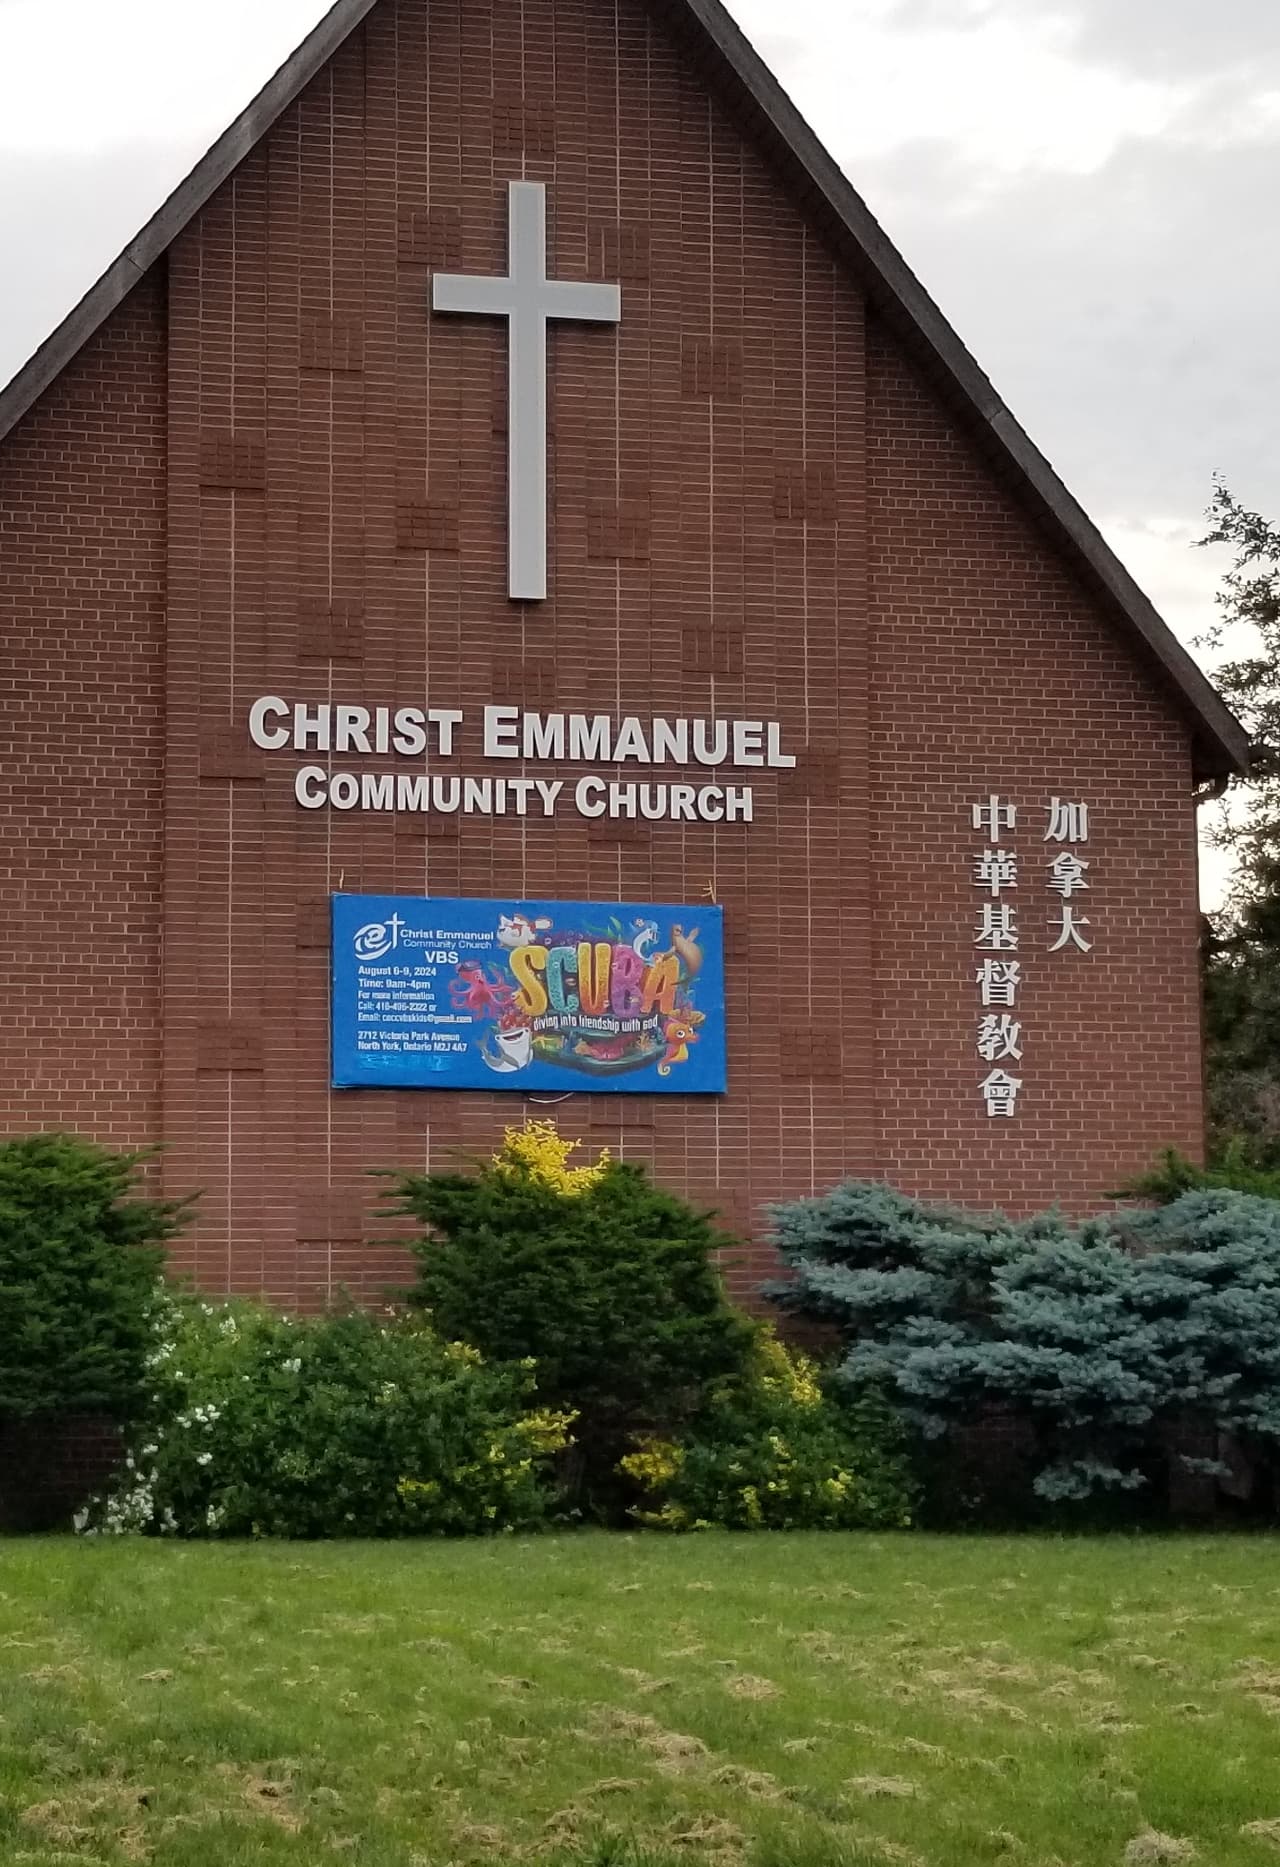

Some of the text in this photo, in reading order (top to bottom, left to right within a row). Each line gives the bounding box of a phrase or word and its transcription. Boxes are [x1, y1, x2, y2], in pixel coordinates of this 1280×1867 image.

[249, 696, 796, 767] CHRIST EMMANUEL
[295, 766, 753, 822] COMMUNITY CHURCH
[1043, 797, 1092, 952] 加拿大
[400, 929, 494, 941] Christ Emmanuel
[403, 939, 492, 950] Community Church
[424, 951, 459, 964] VBS
[358, 966, 391, 977] August
[414, 967, 437, 976] 2024
[358, 979, 384, 988] Time:
[509, 943, 680, 1018] SCUBA
[358, 991, 371, 1000] For
[392, 992, 435, 1001] information
[561, 1014, 577, 1026] into
[579, 1015, 619, 1033] friendship
[621, 1018, 640, 1032] with
[358, 1031, 460, 1042] 2712 Victoria Park Avenue
[358, 1041, 380, 1051] North
[382, 1041, 402, 1052] York,
[403, 1042, 432, 1051] Ontario
[434, 1042, 451, 1051] M2J
